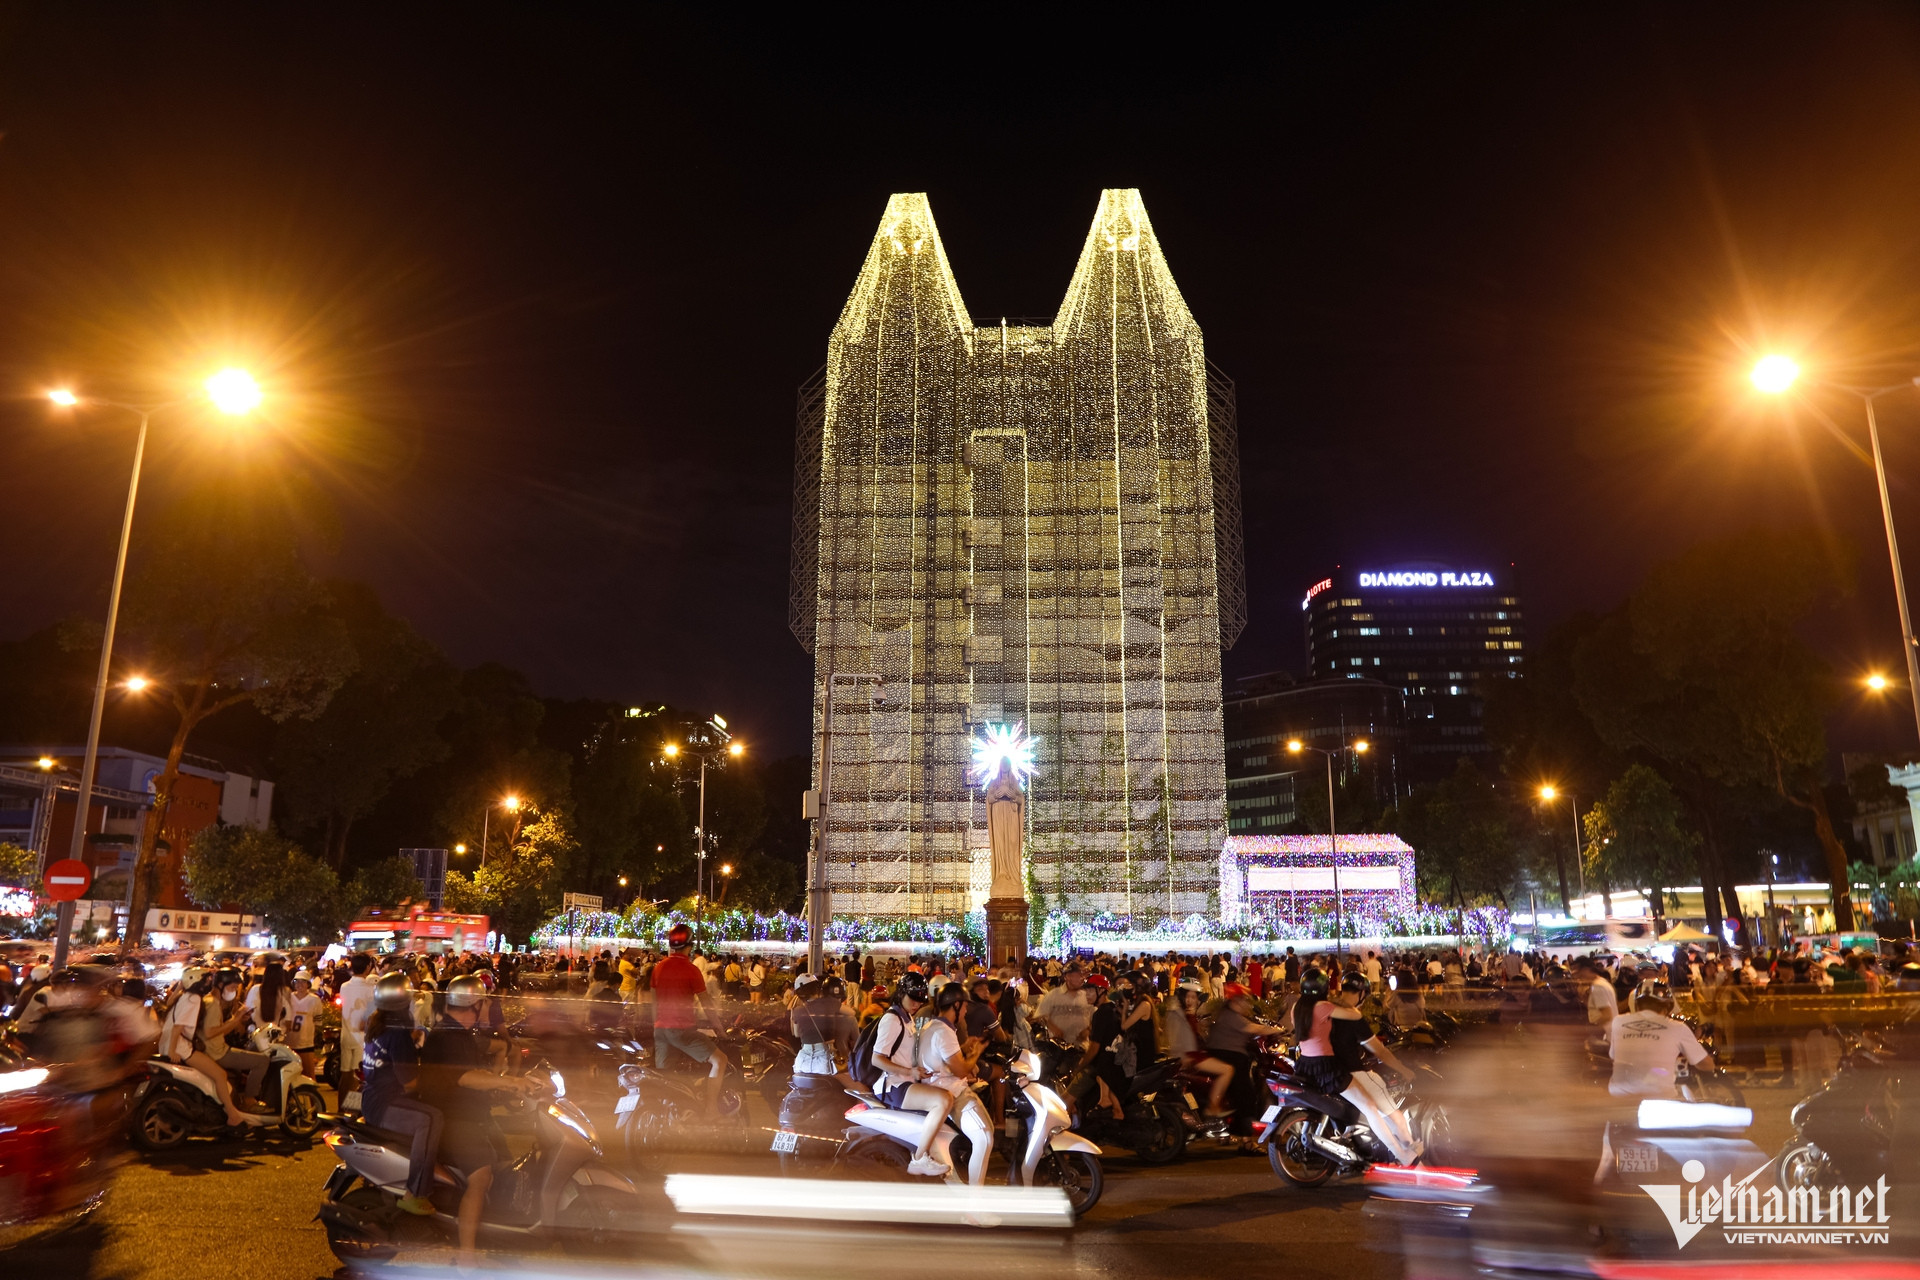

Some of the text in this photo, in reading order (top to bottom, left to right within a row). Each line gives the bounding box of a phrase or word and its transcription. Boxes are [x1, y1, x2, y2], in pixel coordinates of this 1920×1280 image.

[1310, 578, 1332, 597] LOTTE
[1359, 572, 1494, 587] DIAMOND PLAZA
[292, 1015, 303, 1032] 6
